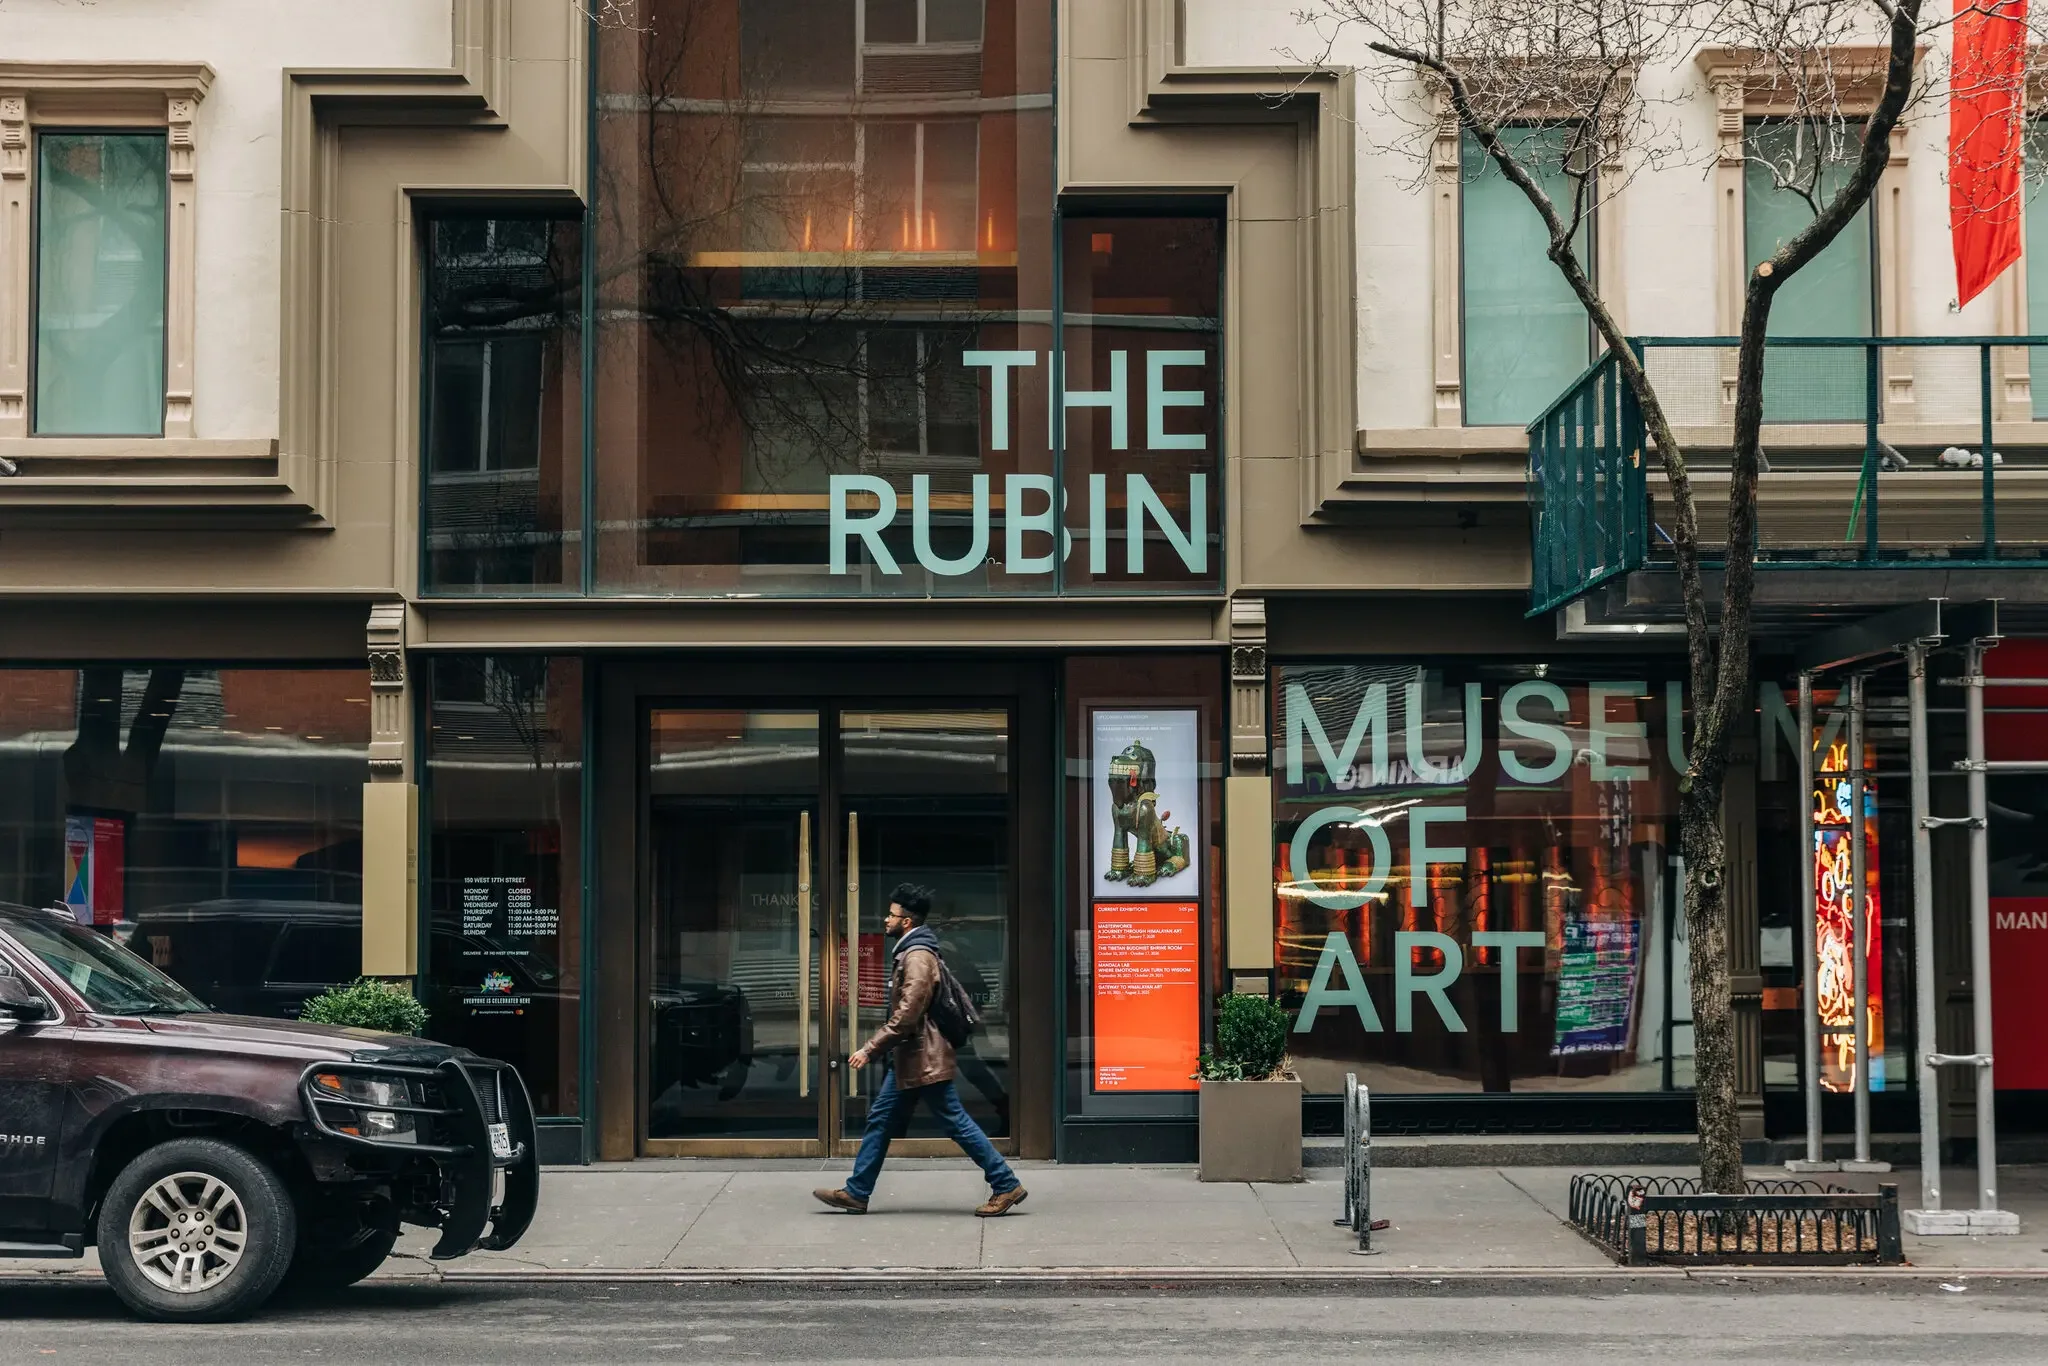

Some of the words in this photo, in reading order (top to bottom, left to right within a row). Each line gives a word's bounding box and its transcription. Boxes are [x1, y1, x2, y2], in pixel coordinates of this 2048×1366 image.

[963, 349, 1206, 451] THE
[829, 473, 1207, 576] RUBIN
[1290, 804, 1467, 910] OF
[1293, 931, 1546, 1033] ART
